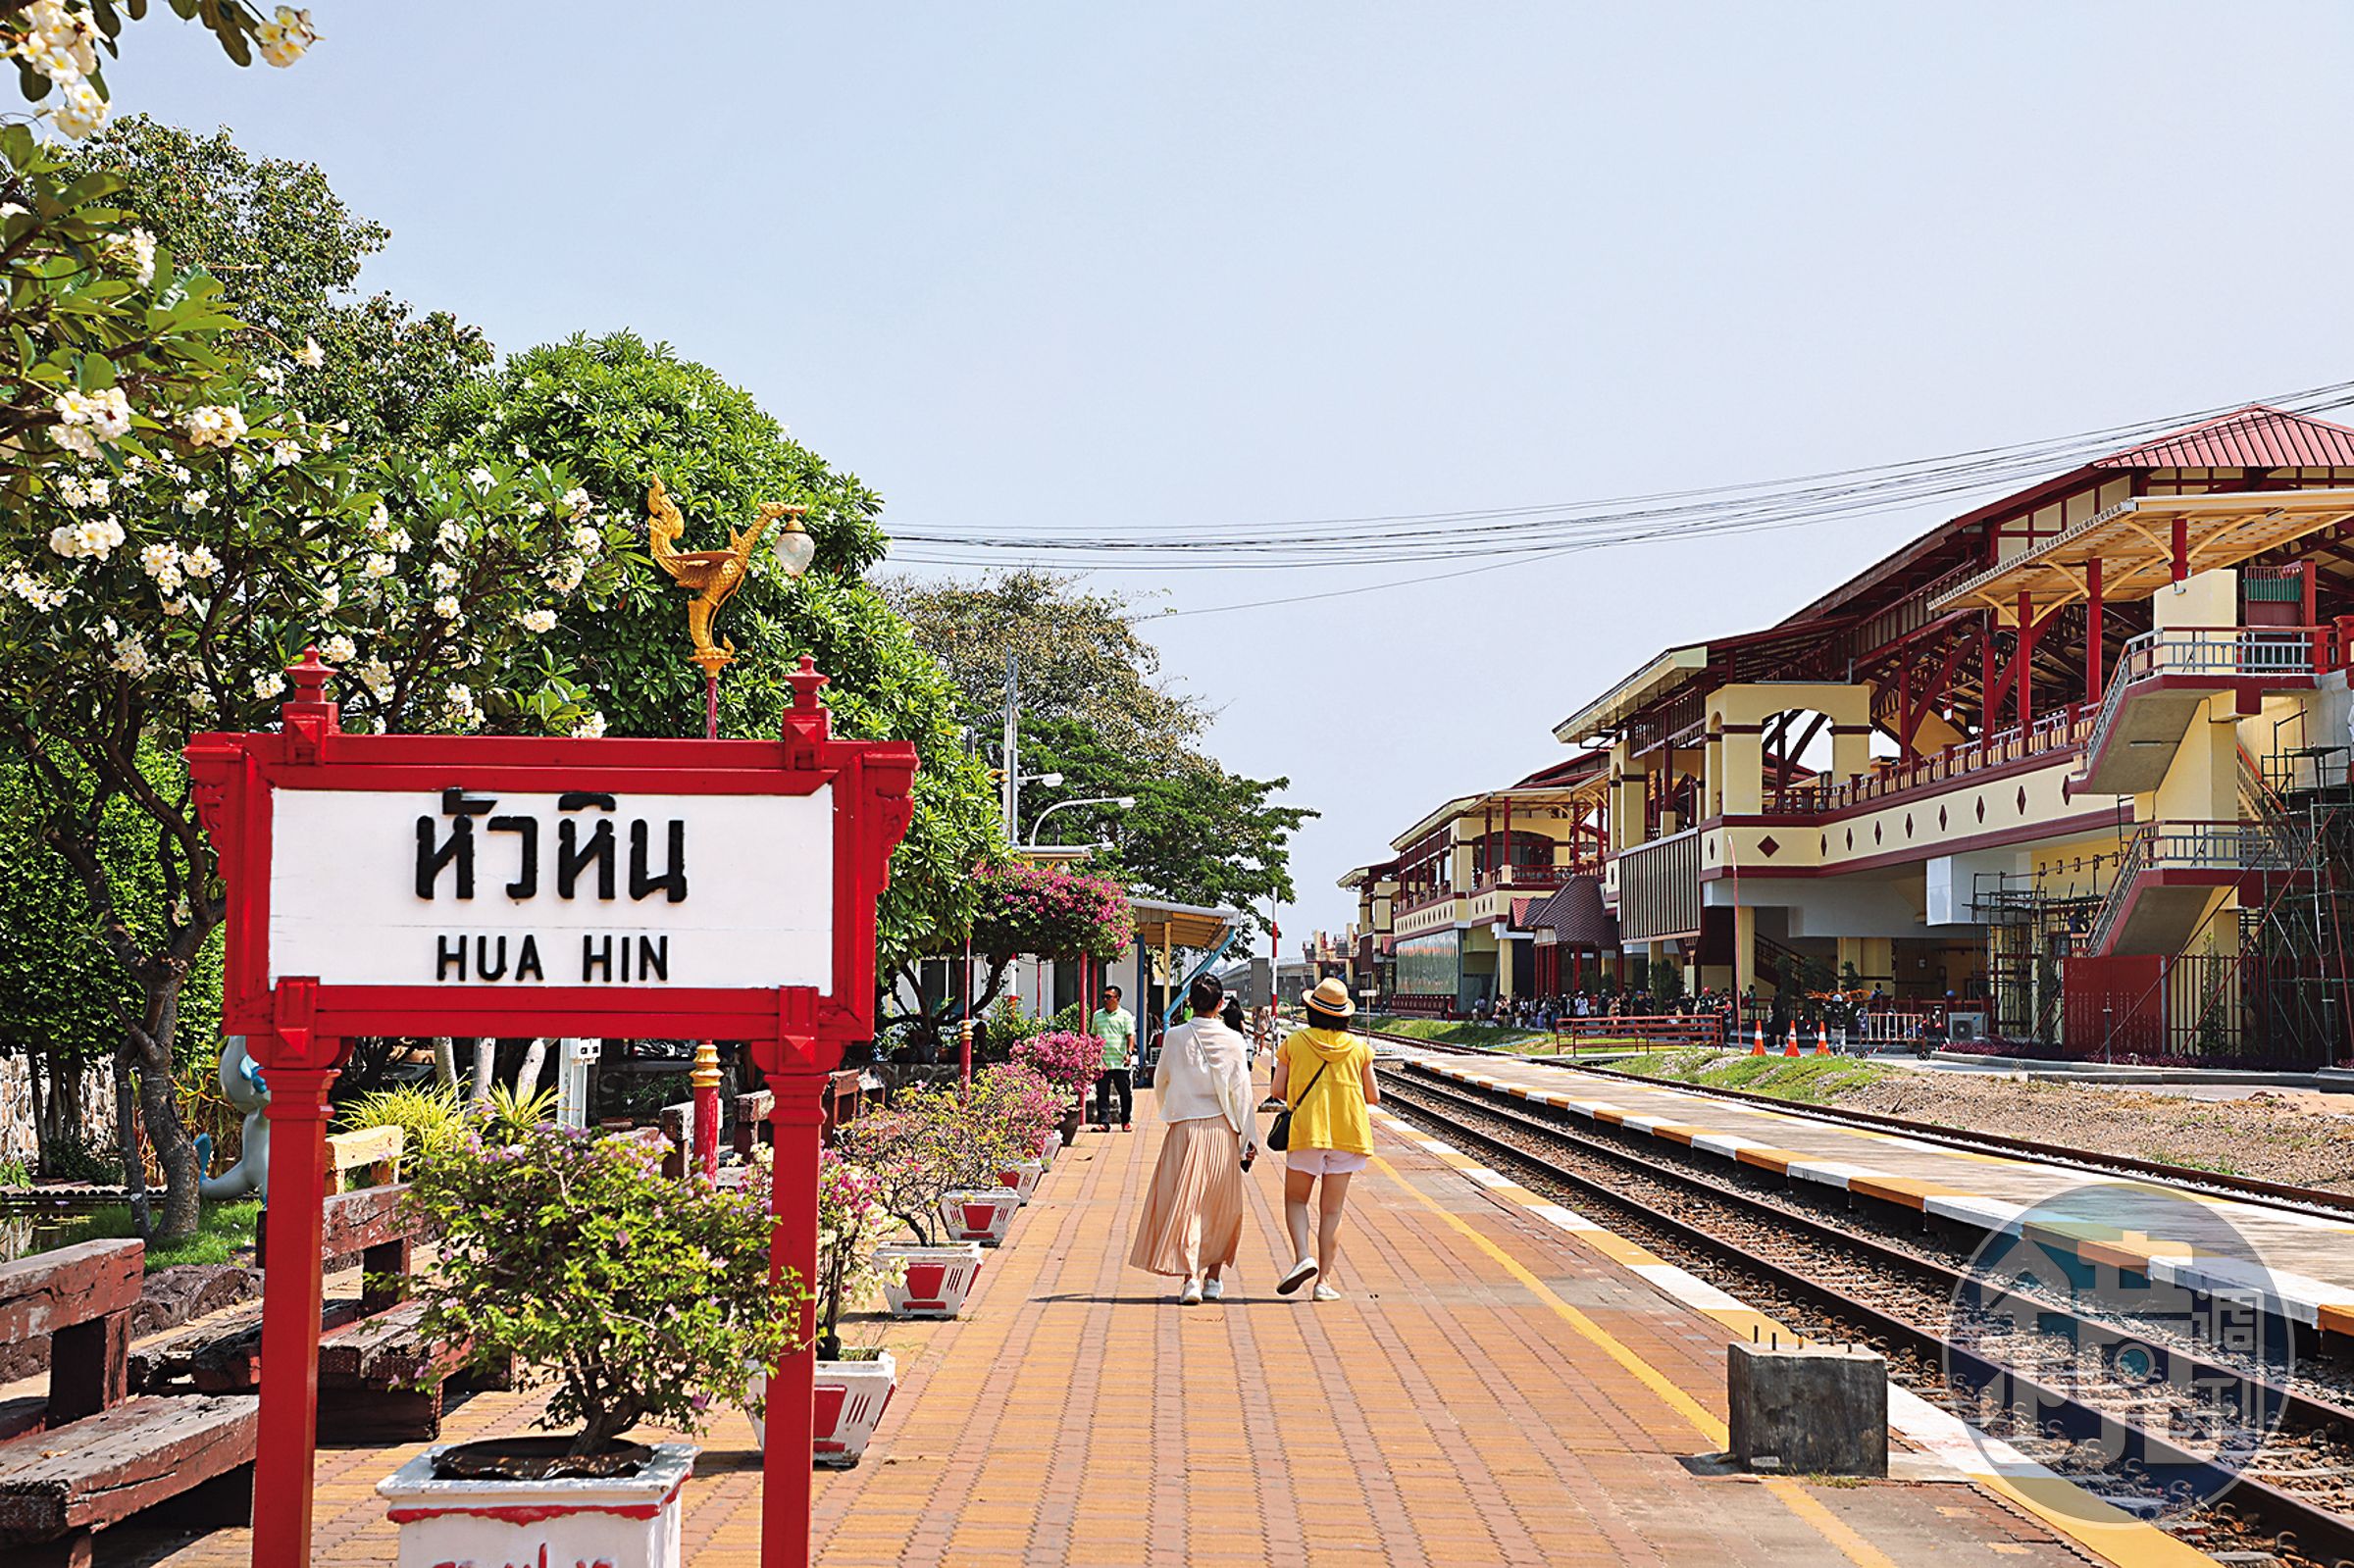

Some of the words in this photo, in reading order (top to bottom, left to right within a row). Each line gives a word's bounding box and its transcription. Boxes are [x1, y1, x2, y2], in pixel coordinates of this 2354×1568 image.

[415, 787, 688, 903] หัวหิน
[436, 935, 544, 982] HUA
[582, 935, 668, 983] HIN
